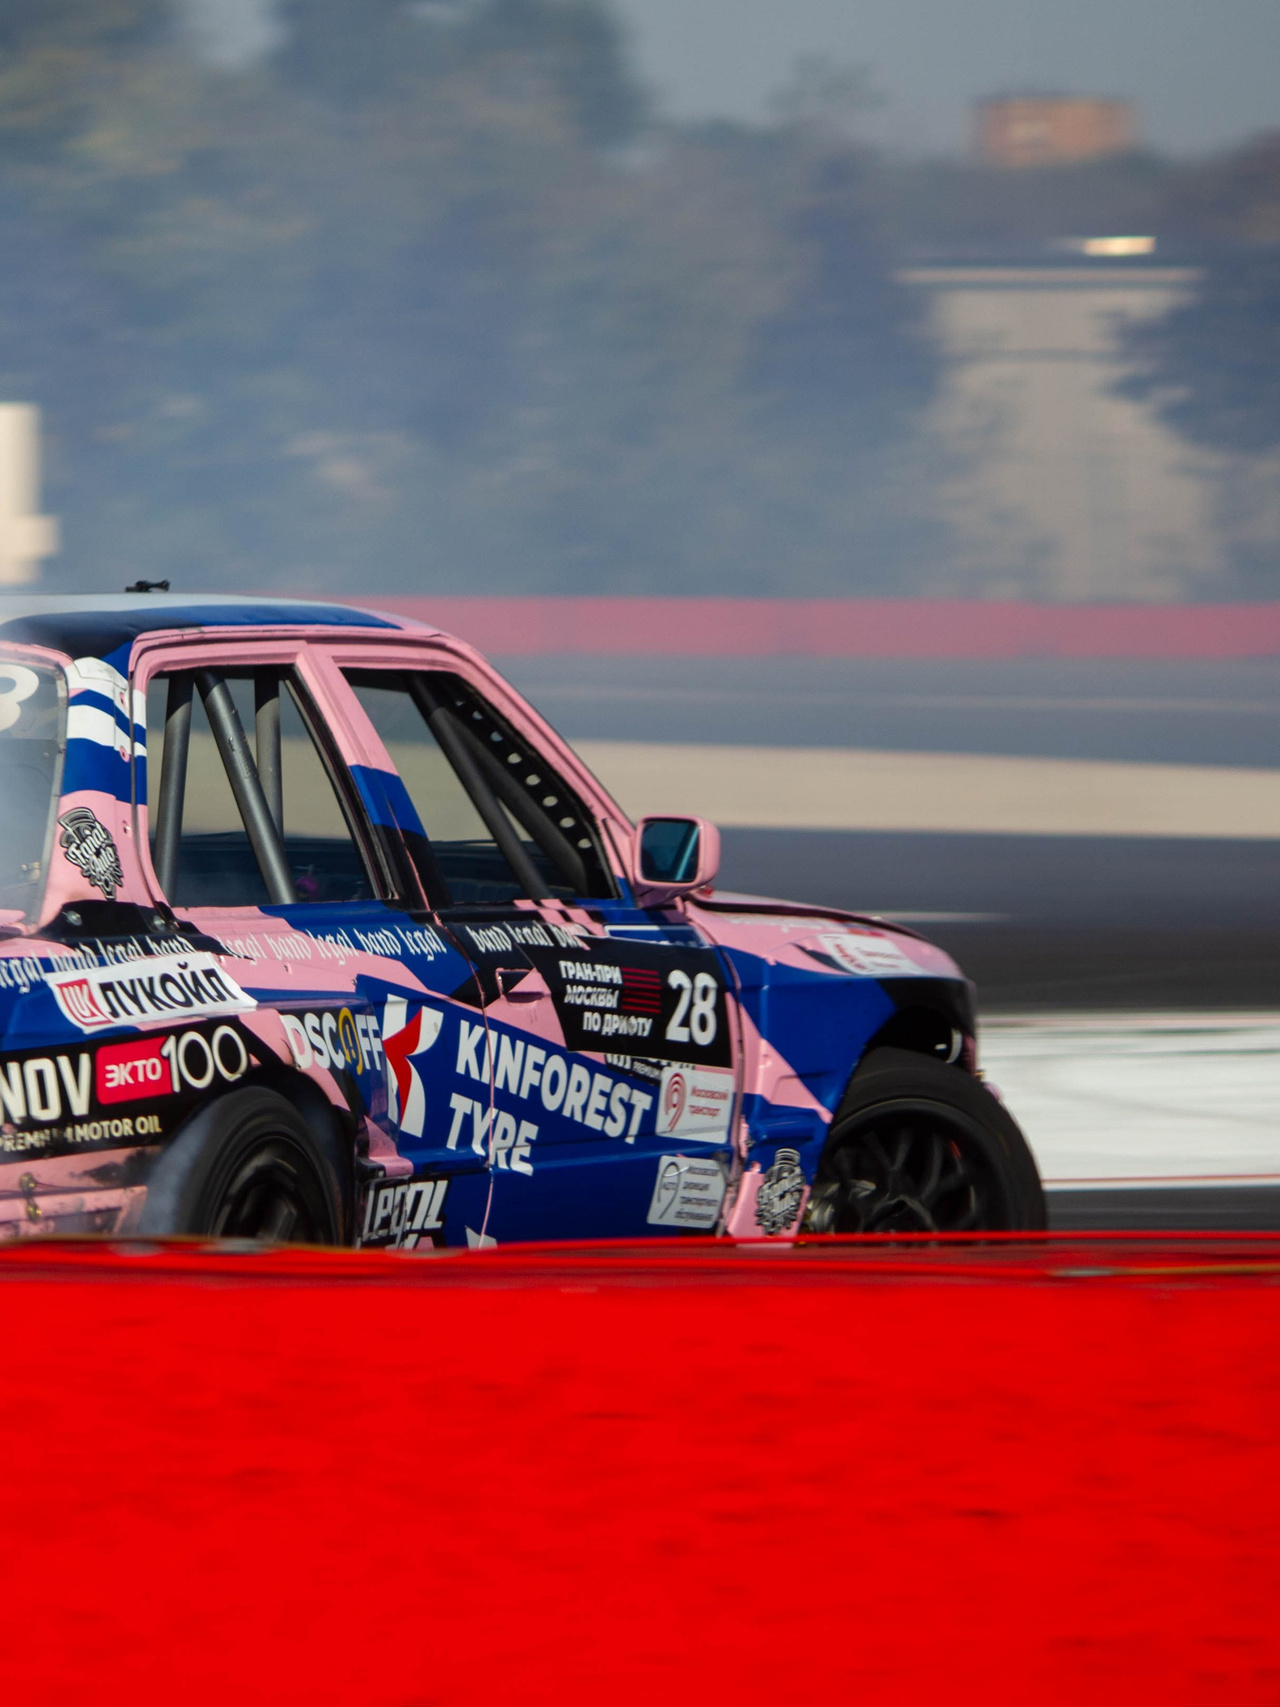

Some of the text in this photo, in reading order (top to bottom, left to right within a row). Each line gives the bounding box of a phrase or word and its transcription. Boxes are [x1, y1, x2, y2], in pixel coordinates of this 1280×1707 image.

[393, 922, 448, 962] legal
[465, 924, 513, 954] band
[98, 961, 238, 1019] ЛУКОЙЛ
[558, 960, 624, 985] ГРАН-ПРИ
[563, 984, 620, 1009] МОСКВЫ
[583, 1011, 653, 1037] ПО ДРИФТУ
[665, 969, 718, 1046] 28
[104, 1024, 248, 1093] ЭКТО 100
[455, 1019, 654, 1145] KINFOREST
[75, 1118, 134, 1143] MOTOR
[135, 1115, 163, 1136] OIL
[446, 1092, 539, 1177] TYRE
